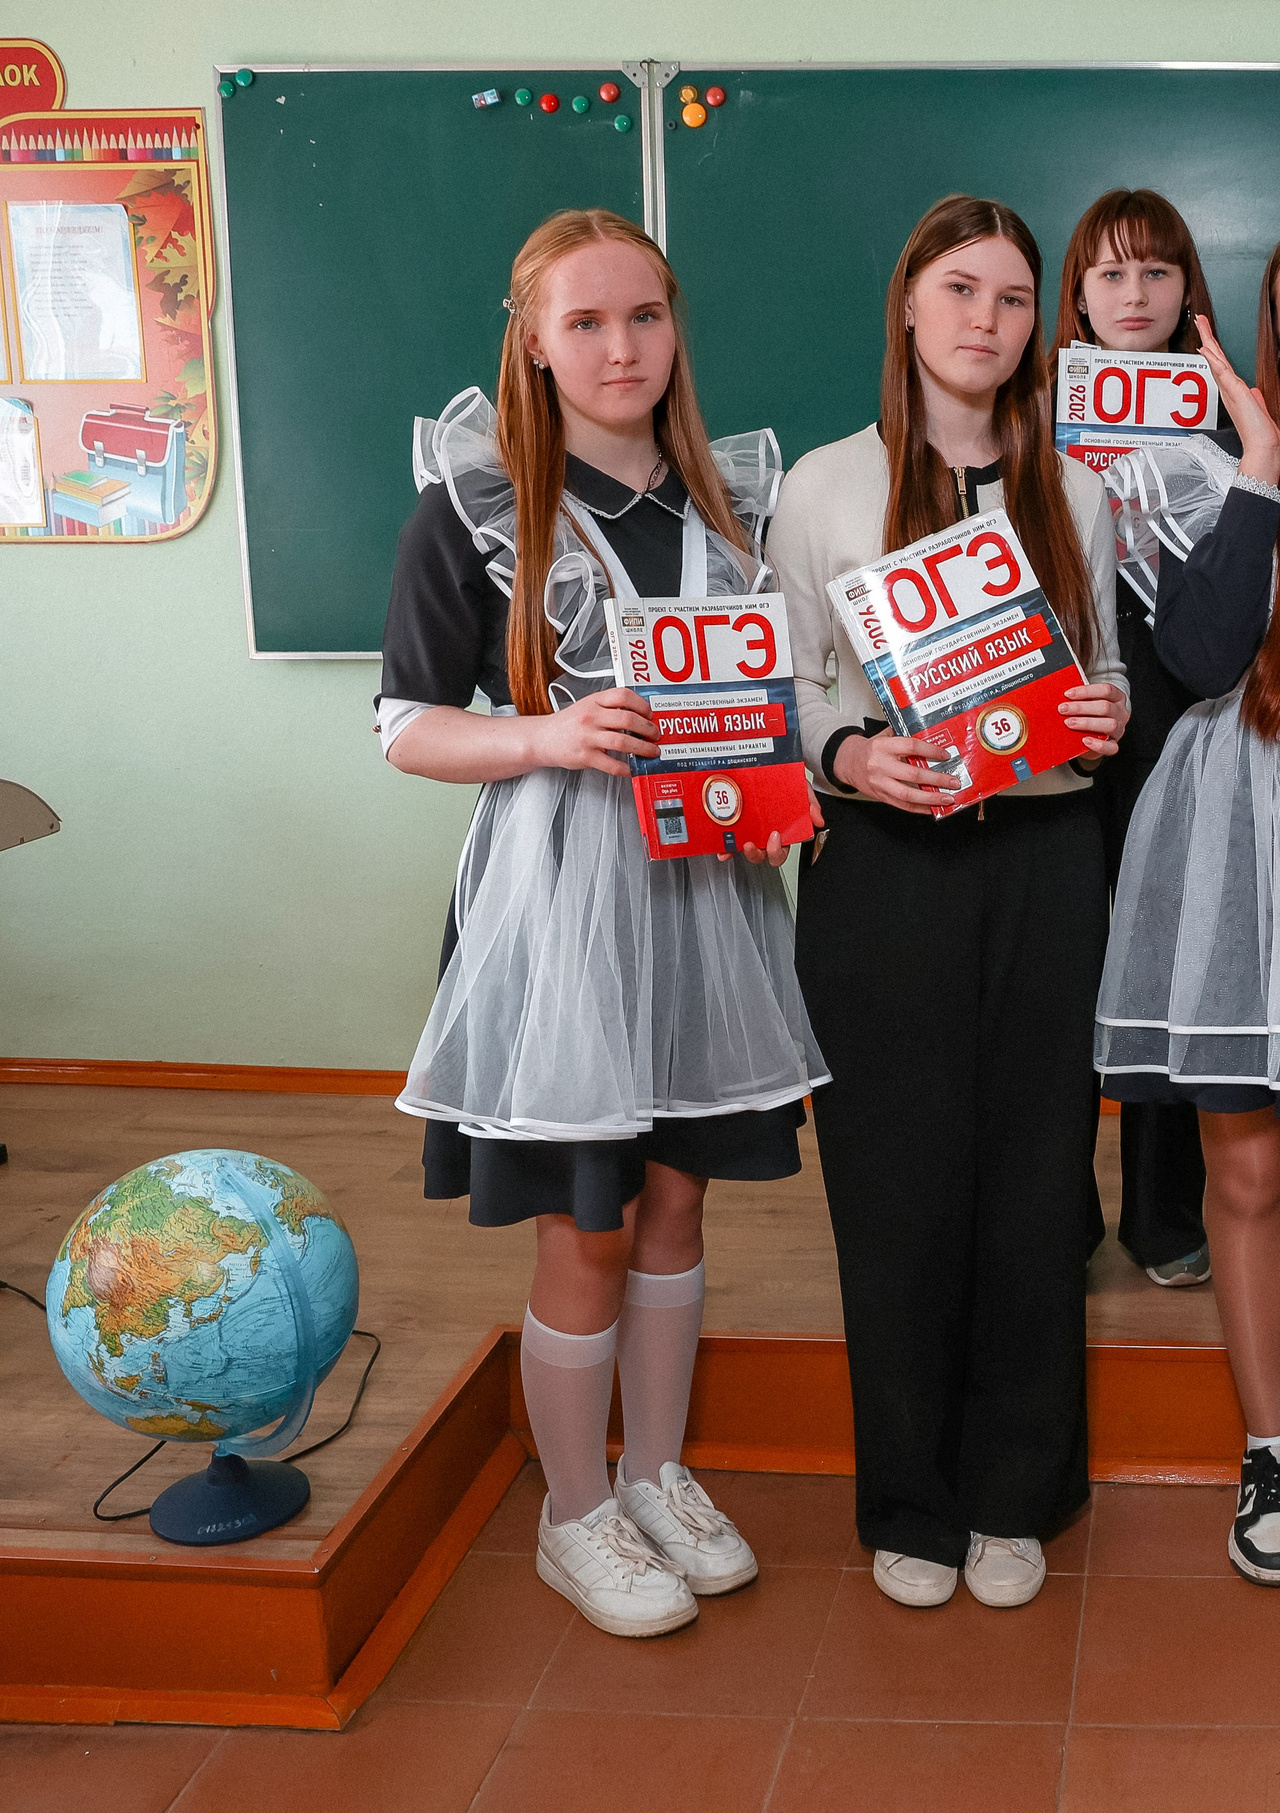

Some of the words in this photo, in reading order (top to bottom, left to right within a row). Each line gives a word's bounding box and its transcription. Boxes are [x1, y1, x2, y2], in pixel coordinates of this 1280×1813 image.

[0, 64, 41, 87] ОК
[1068, 384, 1086, 422] 2026
[1093, 366, 1209, 428] ОГЭ
[1112, 439, 1164, 447] ГОСУДАРСТВЕННЫЙ
[1084, 451, 1126, 467] РУСС
[927, 529, 972, 552] РАЗРАБОТЧИКОВ
[986, 518, 997, 527] ОГЭ
[884, 531, 1021, 634] ОГЭ
[623, 617, 643, 626] ФИПИ
[652, 612, 777, 683] ОГЭ
[902, 650, 934, 668] ОСНОВНОЙ
[934, 625, 992, 654] ГОСУДАРСТВЕННЫЙ
[992, 613, 1020, 628] ЭКЗАМЕН
[628, 639, 651, 683] 2026
[910, 646, 984, 693] РУССКИЙ
[985, 627, 1033, 661] ЯЗЫК
[924, 696, 950, 710] ТИПОВЫЕ
[951, 669, 1006, 698] ЭКЗАМЕНАЦИОННЫЕ
[1008, 656, 1038, 673] ВАРИАНТЫ
[683, 698, 735, 707] ГОСУДАРСТВЕННЫЙ
[658, 712, 719, 736] РУССКИЙ
[724, 712, 766, 732] ЯЗЫК
[991, 717, 1011, 737] 36
[664, 747, 688, 755] ТИПОВЫЕ
[689, 745, 736, 754] ЭКЗАМЕНАЦИОННЫЕ
[739, 742, 767, 751] ВАРИАНТЫ
[714, 790, 729, 805] 36
